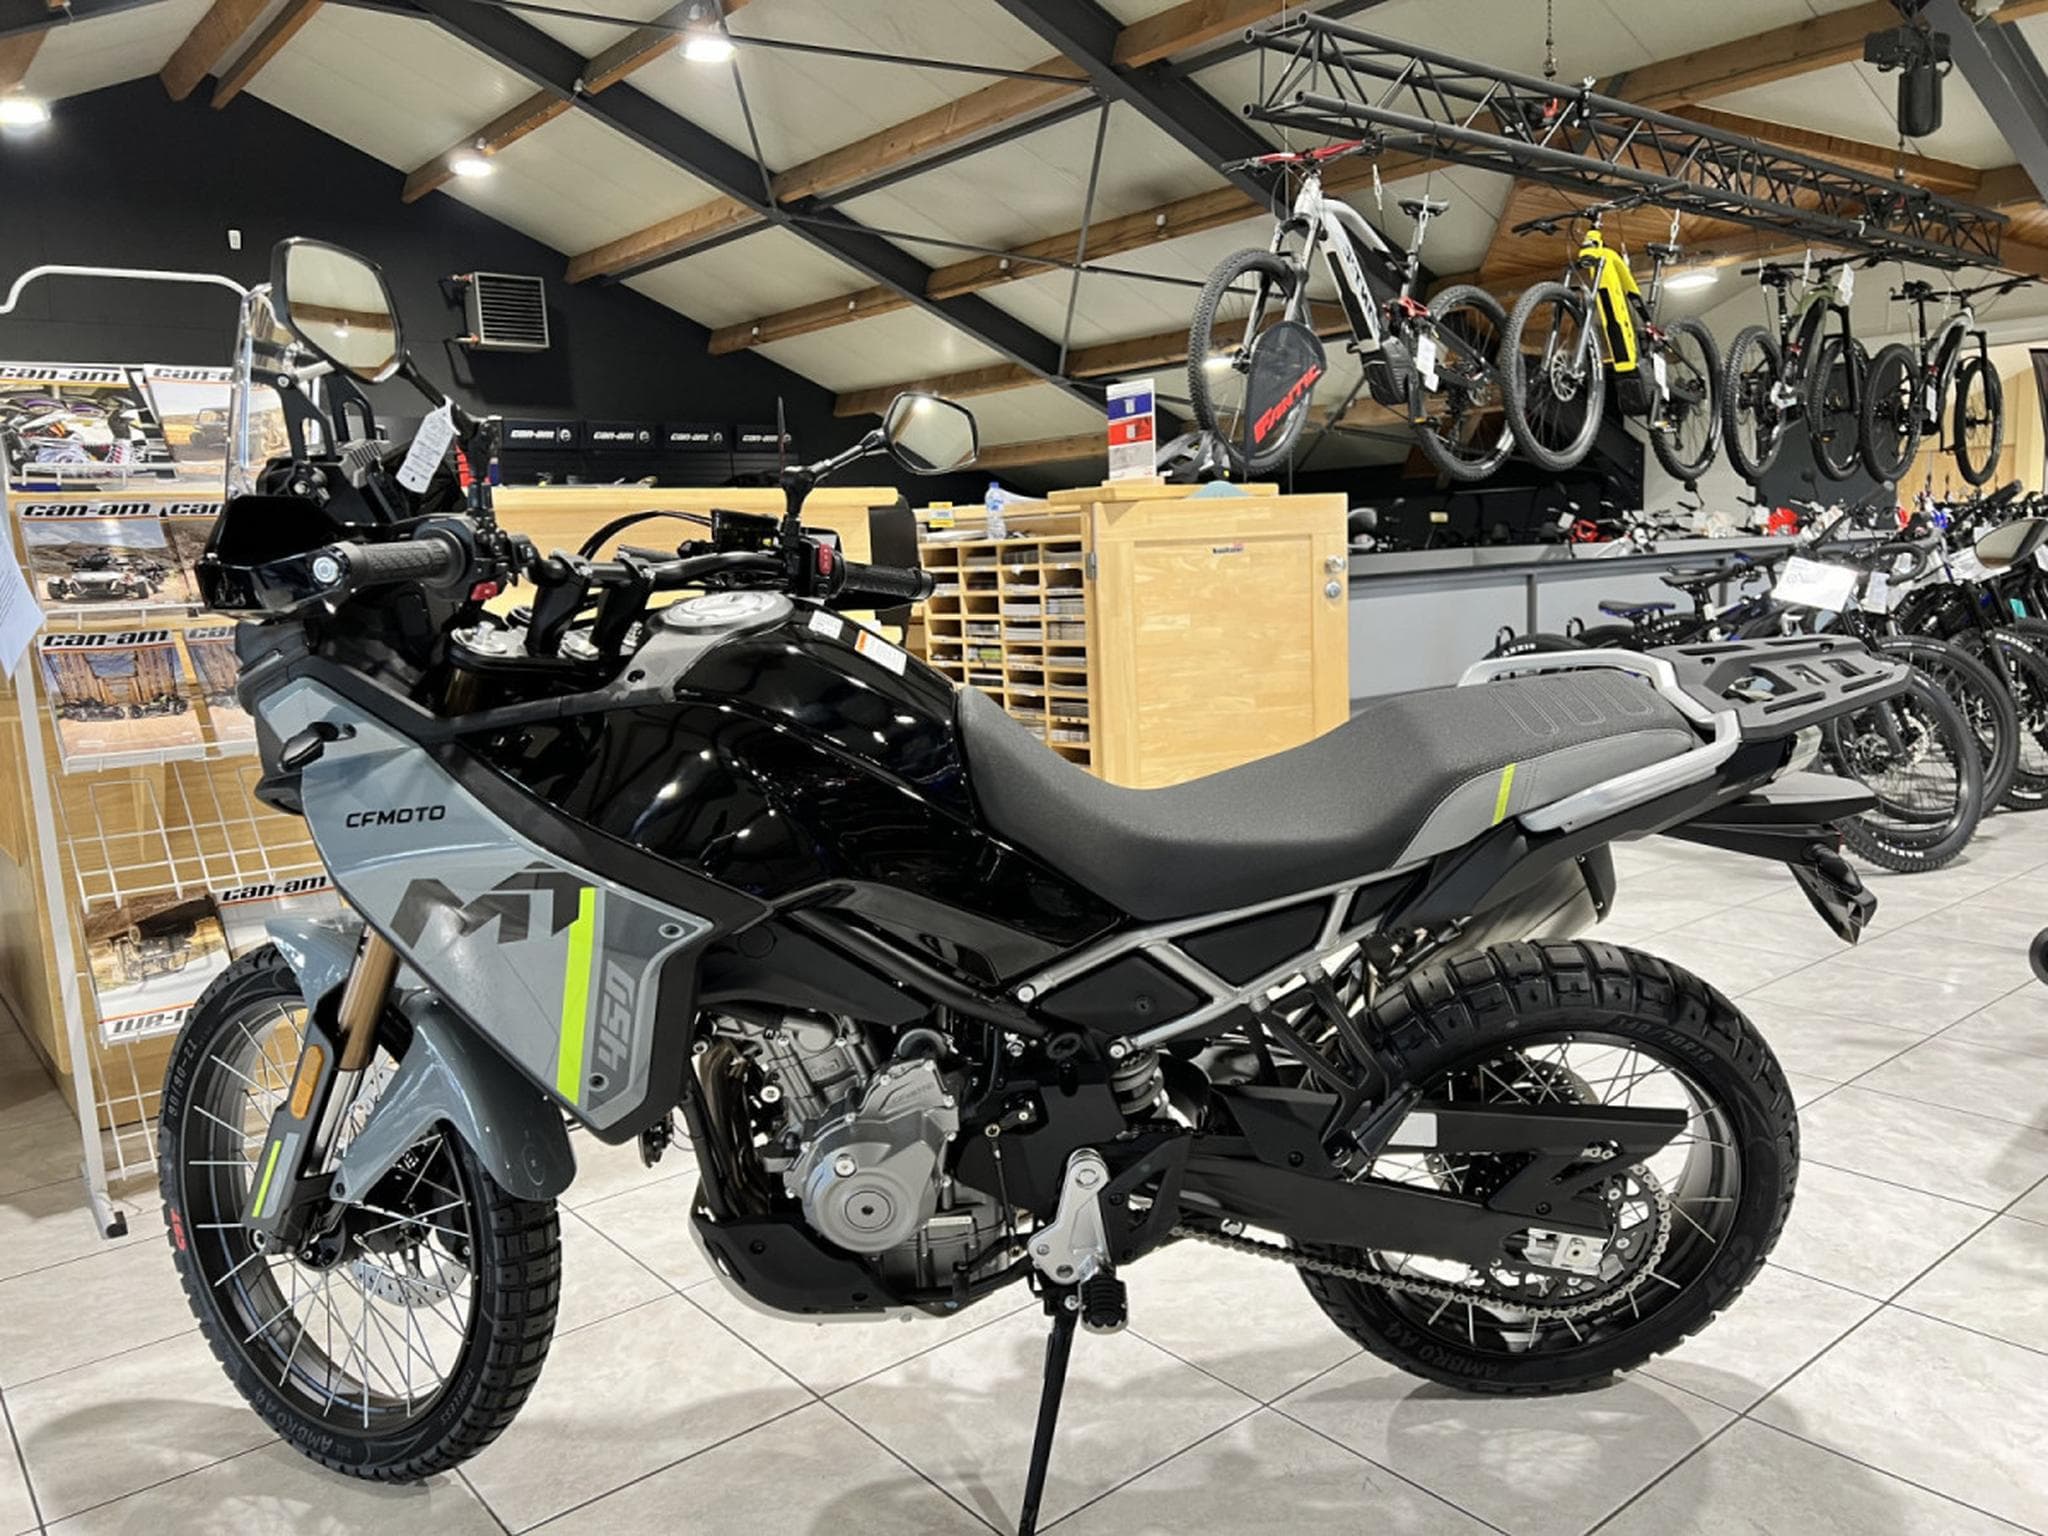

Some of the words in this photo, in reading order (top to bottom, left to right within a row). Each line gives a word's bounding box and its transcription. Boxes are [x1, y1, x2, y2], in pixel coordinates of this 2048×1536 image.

[0, 366, 120, 383] can-am
[153, 367, 233, 381] can-a
[24, 502, 150, 518] can-am
[43, 629, 169, 647] can-am
[345, 805, 446, 829] CFMOTO
[222, 876, 327, 902] can-am
[598, 960, 637, 1072] 450
